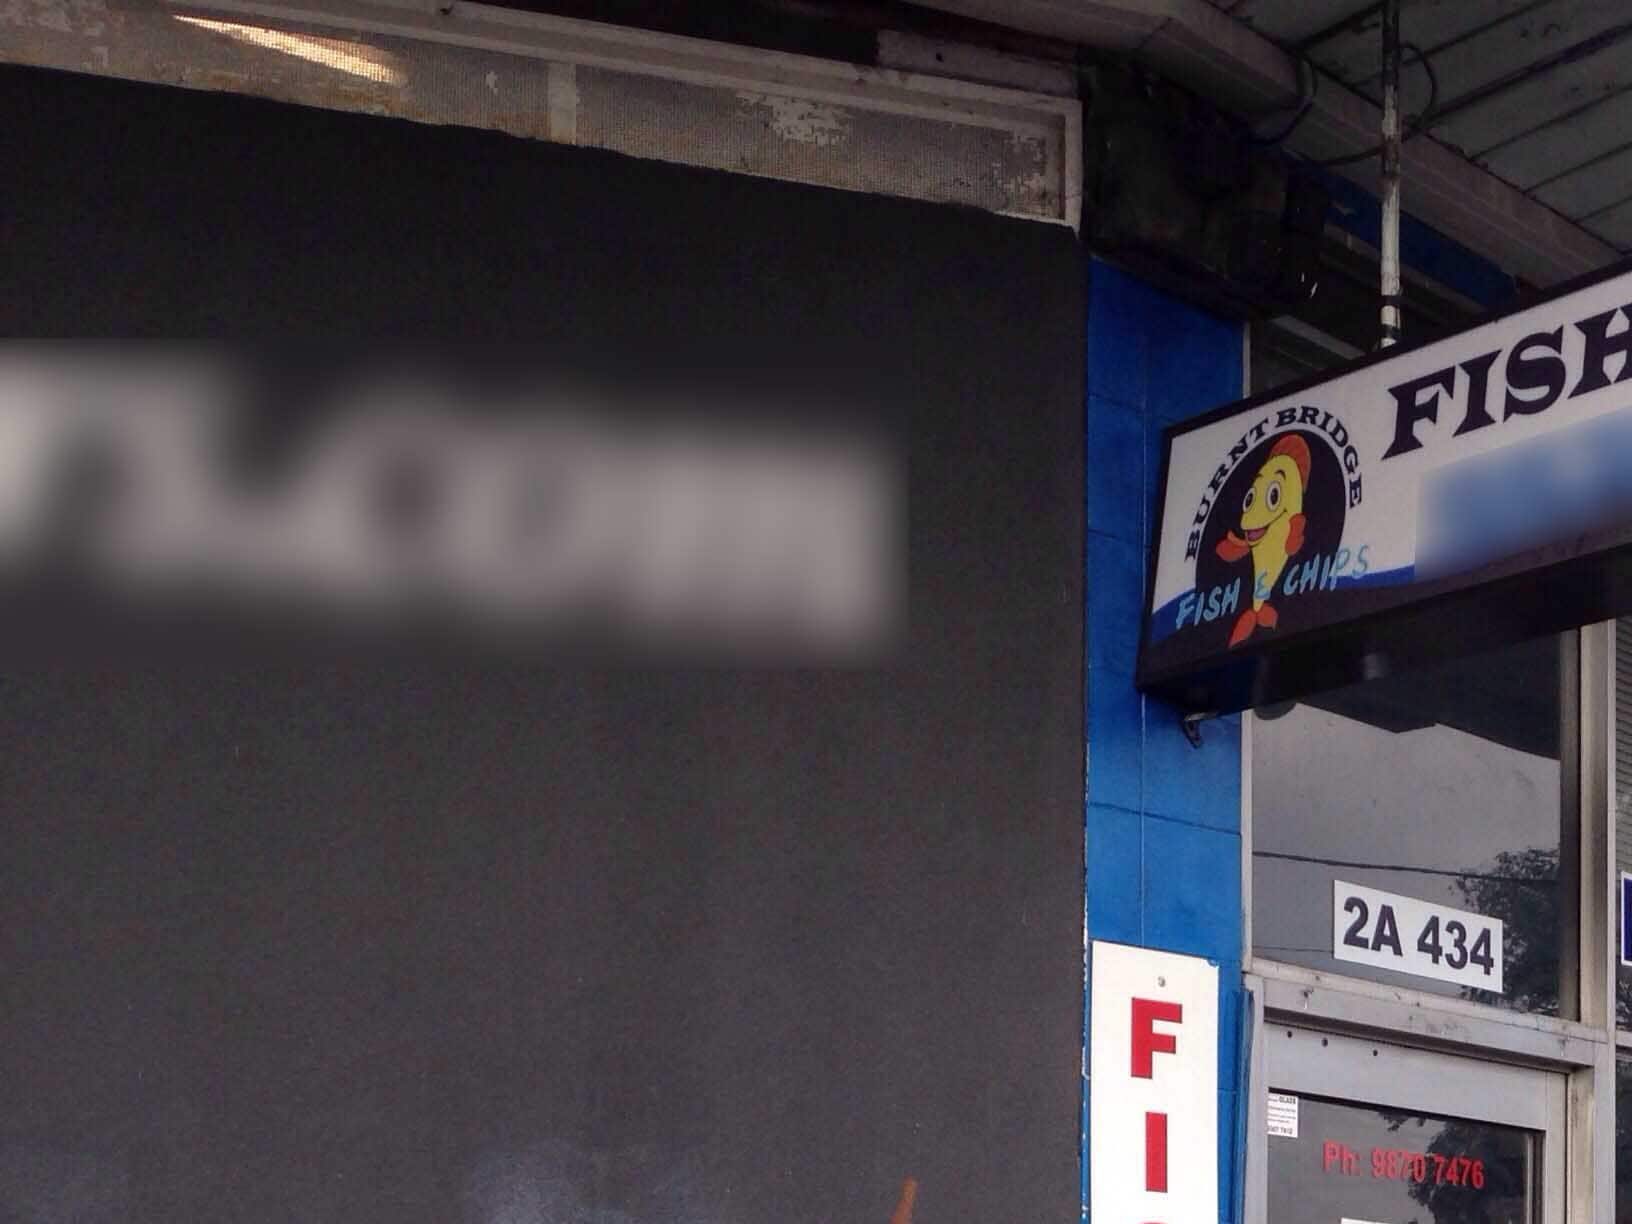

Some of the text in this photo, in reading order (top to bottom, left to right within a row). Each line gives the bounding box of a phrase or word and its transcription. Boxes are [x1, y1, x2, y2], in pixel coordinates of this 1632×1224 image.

[1184, 406, 1362, 563] BURNT BRIDGE
[1176, 577, 1241, 629] FISH
[1283, 544, 1370, 596] CHIPS
[1343, 897, 1494, 975] 2A 434
[1323, 1140, 1484, 1189] Ph: 9870 7476
